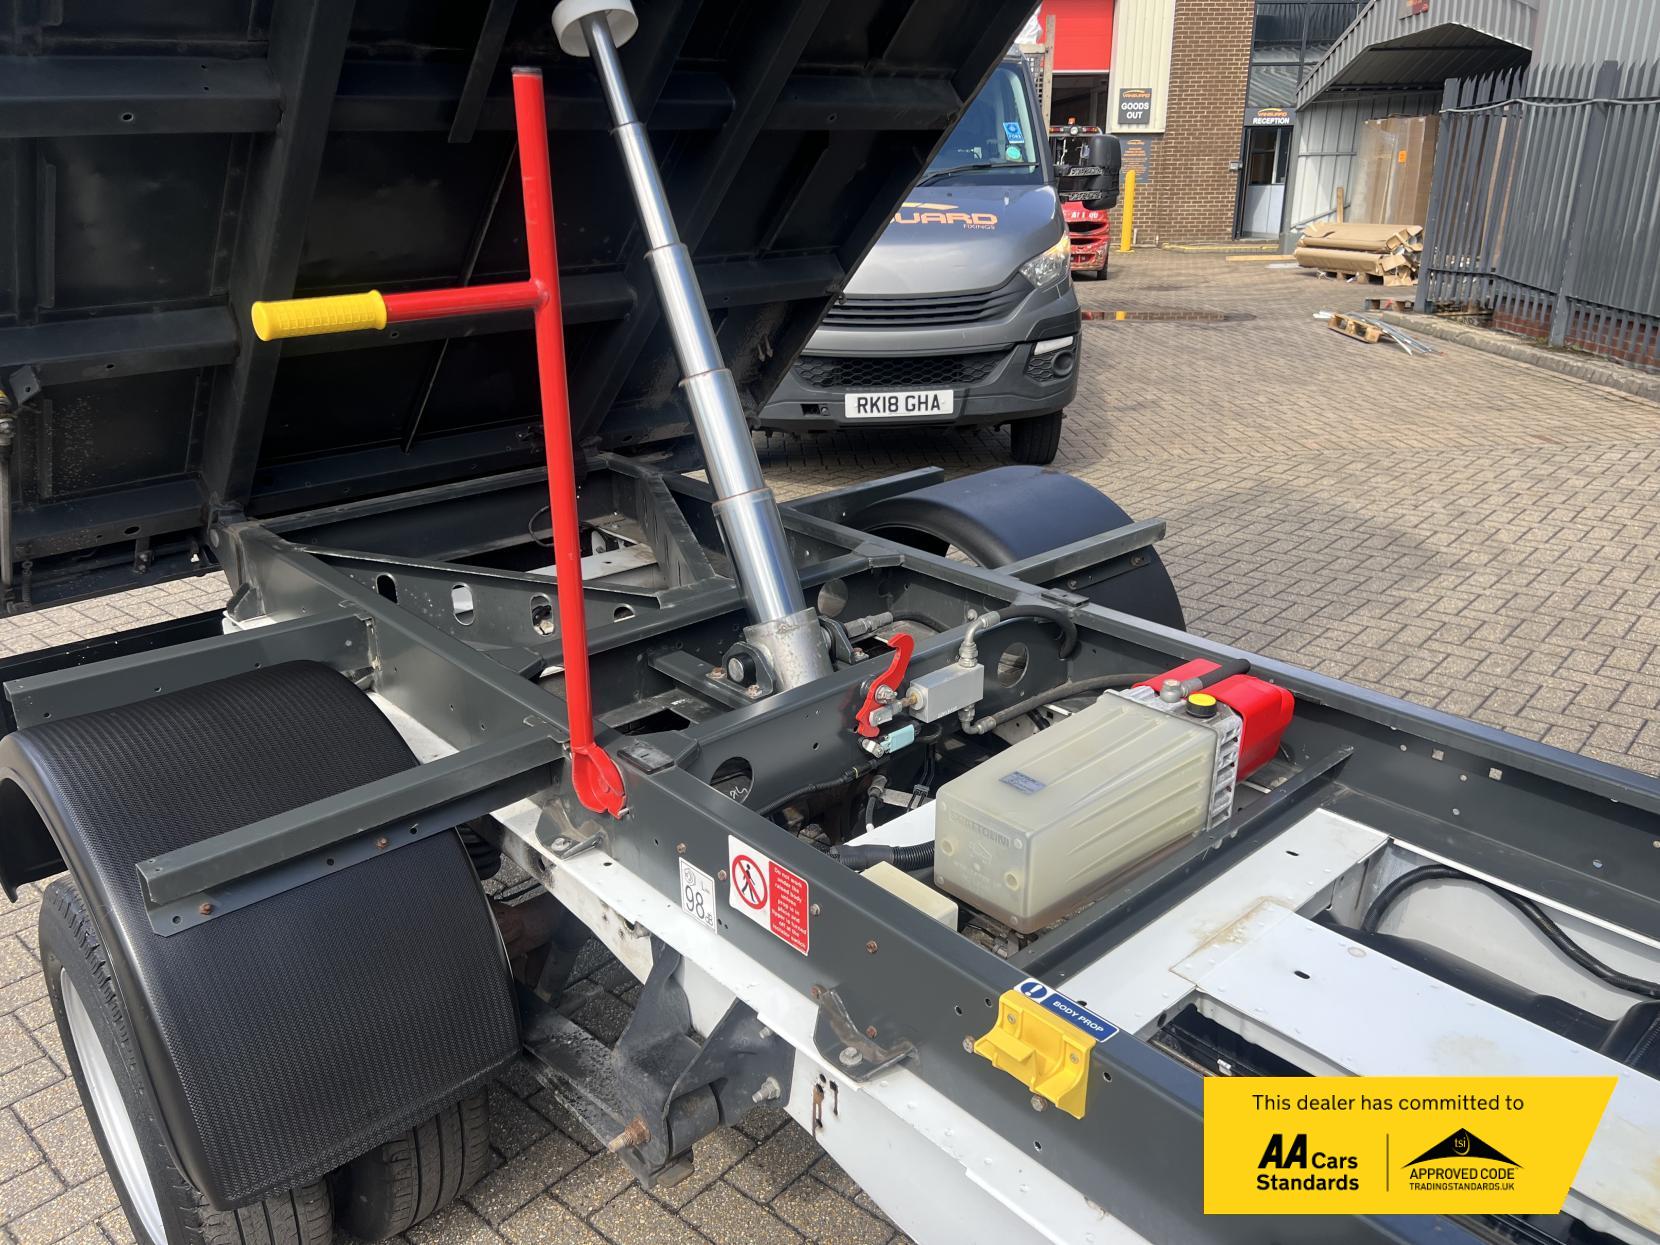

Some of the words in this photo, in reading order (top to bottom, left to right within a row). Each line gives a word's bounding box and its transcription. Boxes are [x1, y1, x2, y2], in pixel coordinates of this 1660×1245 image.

[1121, 102, 1150, 110] GOODS
[1126, 111, 1143, 119] OUT
[1252, 117, 1290, 125] RECEPTION
[889, 212, 998, 225] UARD
[857, 395, 899, 414] RK18
[905, 394, 941, 412] GHA
[685, 884, 705, 920] 98
[1052, 1000, 1080, 1017] BODY
[1077, 1015, 1105, 1032] PROP
